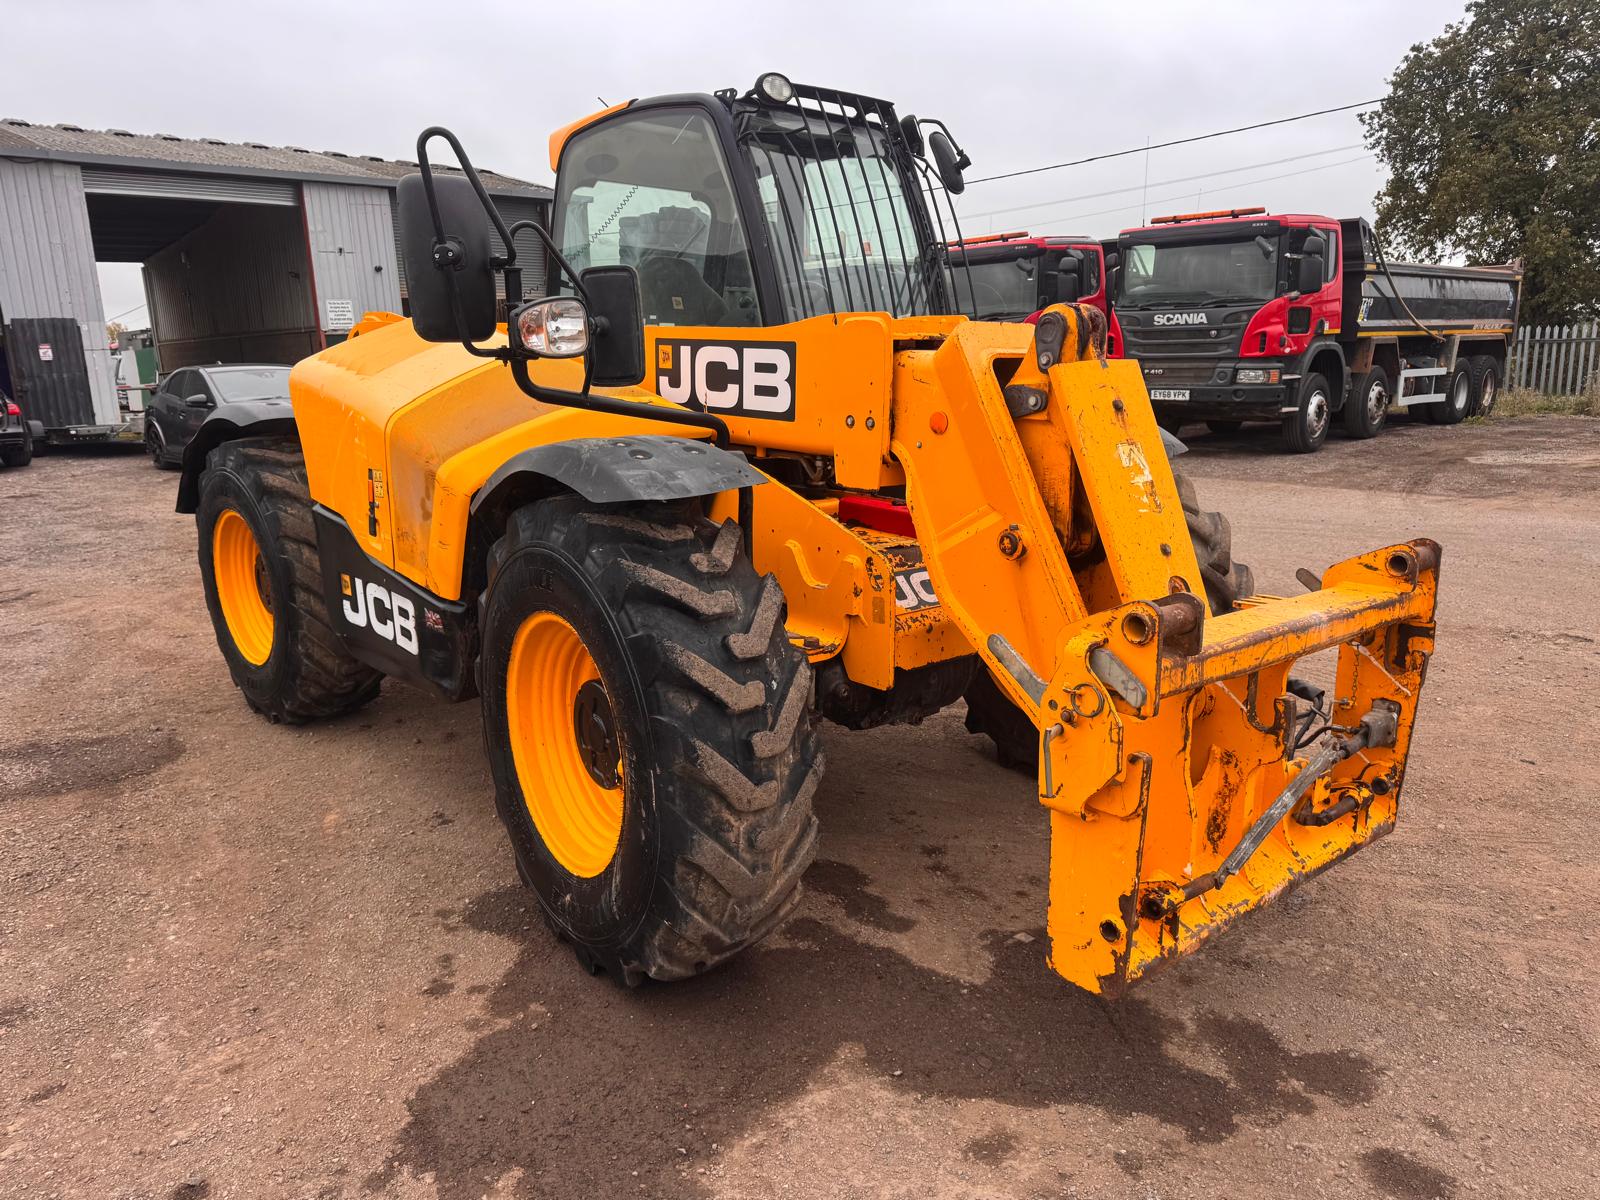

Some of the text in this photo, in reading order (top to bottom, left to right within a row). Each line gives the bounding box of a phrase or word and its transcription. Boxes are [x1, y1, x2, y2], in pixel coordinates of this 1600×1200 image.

[1153, 312, 1208, 325] SCANIA
[658, 345, 792, 413] JCB
[1153, 390, 1187, 399] EY68 VPK
[895, 571, 939, 609] JC
[342, 577, 420, 656] JCB
